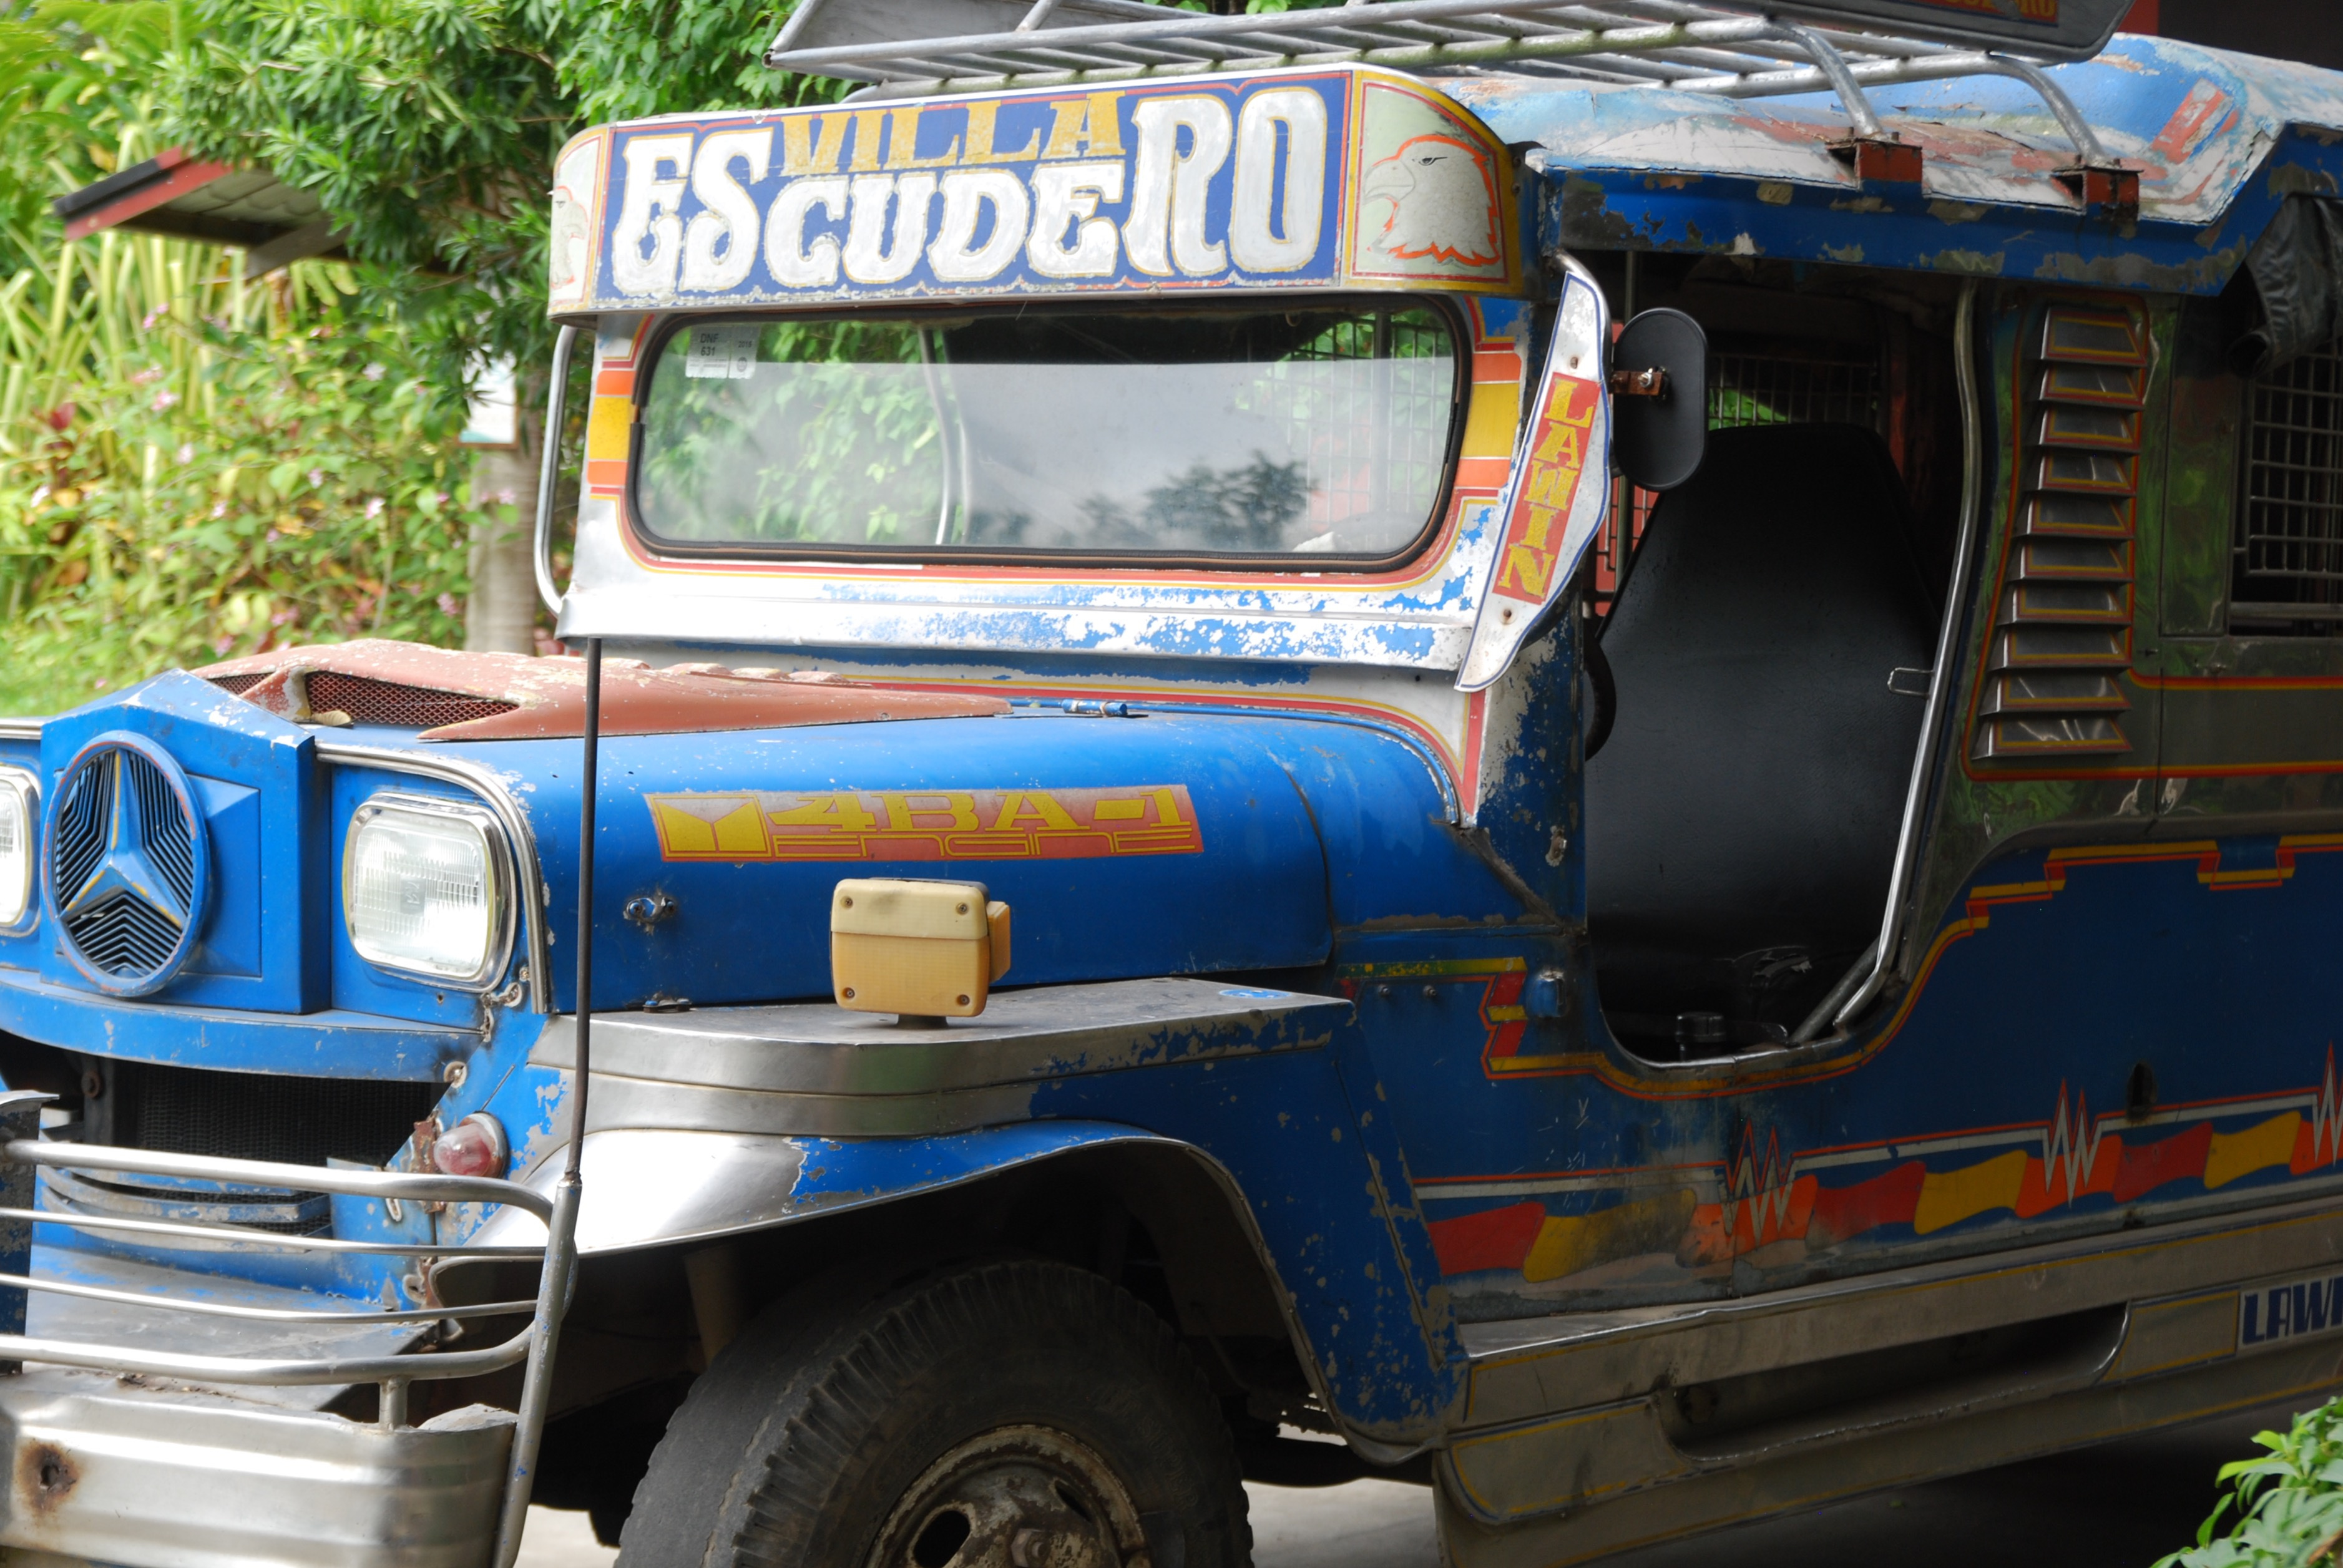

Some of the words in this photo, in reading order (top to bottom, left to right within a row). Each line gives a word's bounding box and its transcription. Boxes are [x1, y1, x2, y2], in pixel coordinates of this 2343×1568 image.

[780, 90, 1127, 177] VILLA
[612, 86, 1327, 293] ESCUDERO
[700, 333, 720, 344] DNF
[700, 346, 716, 356] 631
[1499, 378, 1594, 598] LAWIN
[766, 788, 1192, 832] 4BA-1
